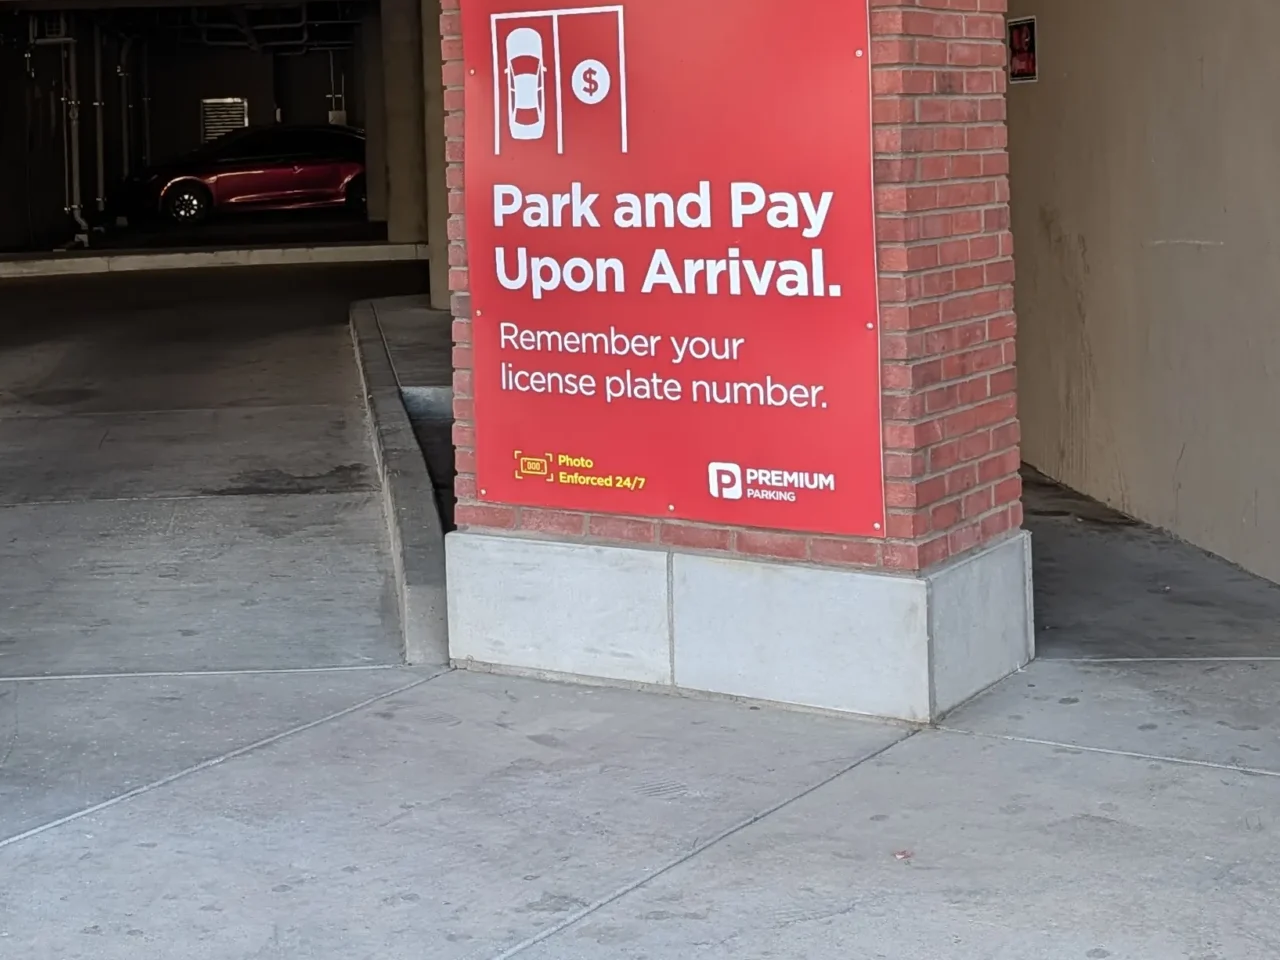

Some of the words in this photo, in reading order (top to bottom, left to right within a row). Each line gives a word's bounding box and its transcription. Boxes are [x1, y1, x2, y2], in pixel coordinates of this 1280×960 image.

[582, 68, 599, 97] $
[493, 182, 601, 228] Park
[613, 180, 711, 228] and
[730, 182, 834, 239] Pay
[494, 246, 625, 300] Upon
[641, 247, 841, 298] Arrival.
[500, 322, 661, 356] Remember
[670, 334, 744, 364] your
[501, 362, 596, 397] license
[605, 369, 681, 403] plate
[692, 376, 827, 409] number.
[558, 454, 593, 468] Photo
[559, 472, 612, 487] Enforced
[615, 476, 645, 491] 24/7
[746, 468, 835, 491] PREMIUM
[746, 488, 796, 502] PARKING
